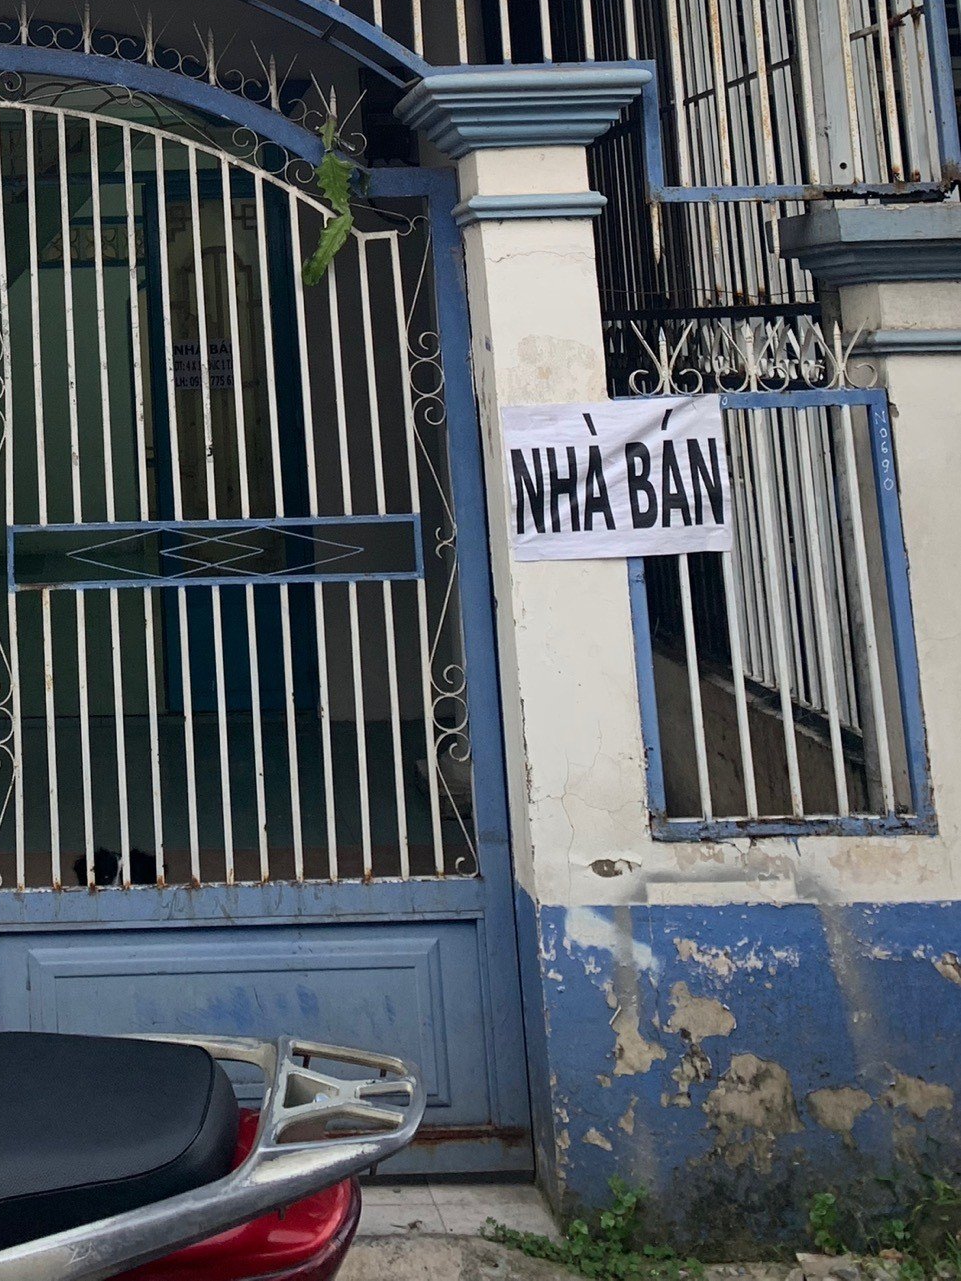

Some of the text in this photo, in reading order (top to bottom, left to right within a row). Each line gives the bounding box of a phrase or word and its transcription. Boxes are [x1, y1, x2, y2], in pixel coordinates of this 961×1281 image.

[209, 340, 238, 354] BÁ
[510, 408, 725, 535] NHÀ BÁN
